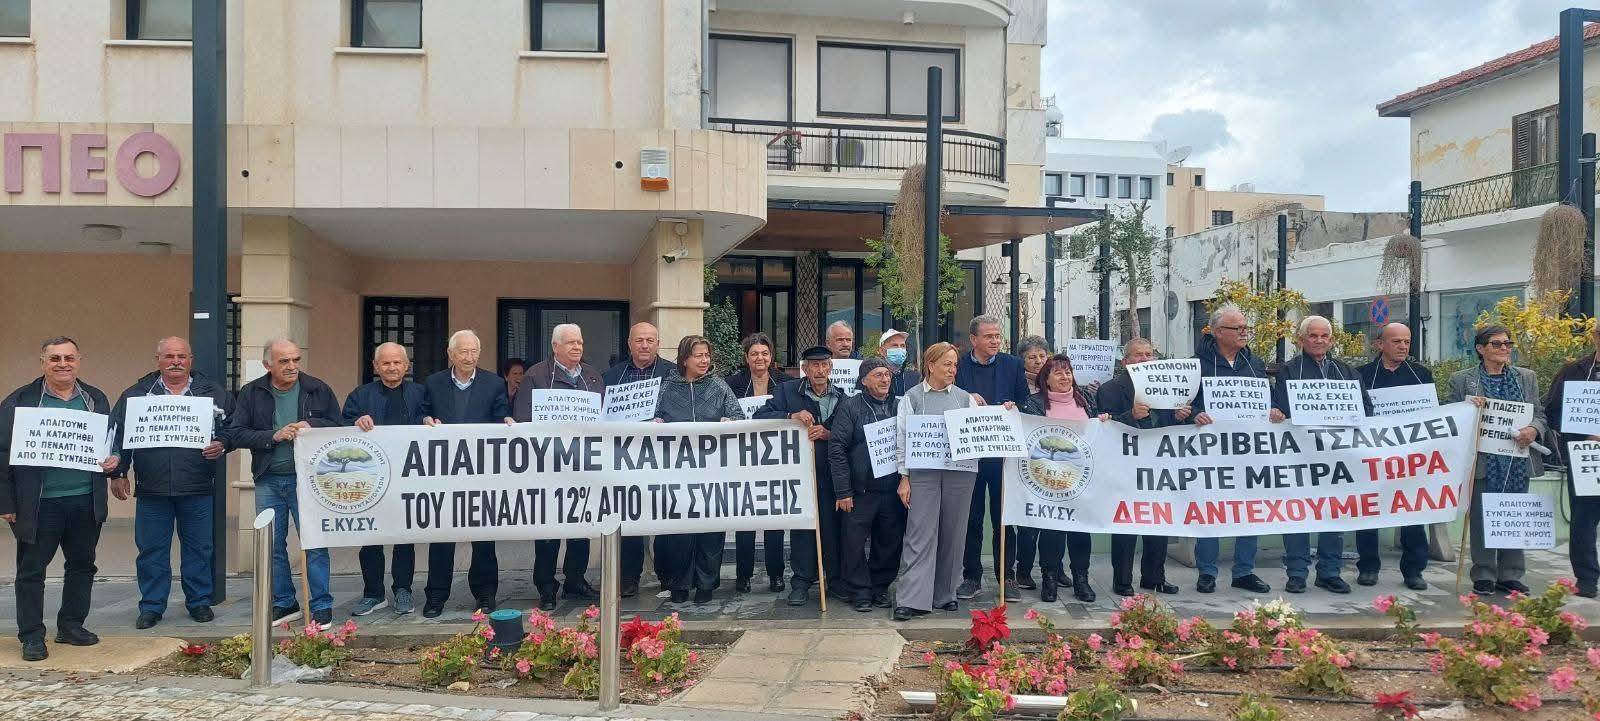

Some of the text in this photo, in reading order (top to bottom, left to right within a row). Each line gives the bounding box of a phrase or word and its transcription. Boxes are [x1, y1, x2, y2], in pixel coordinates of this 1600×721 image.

[4, 132, 181, 197] ΠΕΟ
[1142, 362, 1197, 371] ΥΠΟΜΟΝΗ
[1148, 375, 1188, 383] ΕΧΕΙ ΤΑ
[1216, 379, 1268, 388] ΑΚΡΙΒΕΙΑ
[617, 379, 660, 393] ΑΚΡΙΒΕΙΑ
[1301, 382, 1358, 390] ΑΚΡΙΒΕΙΑ
[610, 390, 654, 404] ΜΑΣ ΕΧΕΙ
[1145, 387, 1190, 397] ΟΡΙΑ ΤΗΣ
[1212, 390, 1263, 399] ΜΑΣ ΕΧΕΙ
[547, 396, 590, 404] ΑΠΑΙΤΟΥΜΕ
[1210, 401, 1268, 410] ΓΟΝΑΤΙΣΕΙ
[606, 399, 654, 415] ΓΟΝΑΤΙΣΕΙ
[1492, 402, 1525, 414] ΠΑΙΖΕΤΕ
[40, 419, 87, 430] ΑΠΑΙΤΟΥΜΕ
[965, 415, 1003, 424] ΑΠΑΙΤΟΥΜΕ
[1481, 415, 1514, 426] ΜΕ ΤΗΝ
[46, 431, 94, 442] ΚΑΤΑΡΓΗΘΕΙ
[165, 435, 205, 443] ΣΥΝΤΑΞΕΙΣ
[972, 435, 999, 443] ΠΕΝΑΛΤΙ
[1122, 415, 1459, 458] Η ΑΚΡΙΒΕΙΑ ΤΣΑΚΙΖΕΙ
[41, 441, 76, 451] ΠΕΝΑΛΤΙ
[339, 437, 374, 450] ΠΟΙΟΤΗΤΑ
[401, 429, 800, 477] ΑΠΑΙΤΟΥΜΕ ΚΑΤΑΡΓΗΣΗ
[874, 449, 882, 457] ΣΕ
[956, 447, 971, 455] ΑΠΟ
[41, 452, 54, 460] ΤΙΣ
[59, 454, 98, 465] ΣΥΝΤΑΞΕΙΣ
[1136, 450, 1451, 491] ΠΑΡΤΕ ΜΕΤΡΑ ΤΩΡΑ
[401, 479, 802, 530] ΤΟΥ ΠΕΝΑΛΤΙ 12% ΑΠΟ ΤΙΣ ΣΥΝΤΑΞΕΙΣ
[1112, 500, 1173, 525] ΔΕΝ
[1183, 492, 1380, 525] ΑΝΤΕΧΟΥΜΕ
[1025, 502, 1075, 521] Ε.ΚΥ.ΣΥ.
[322, 517, 378, 532] Ε.ΚΥ.ΣΥ.
